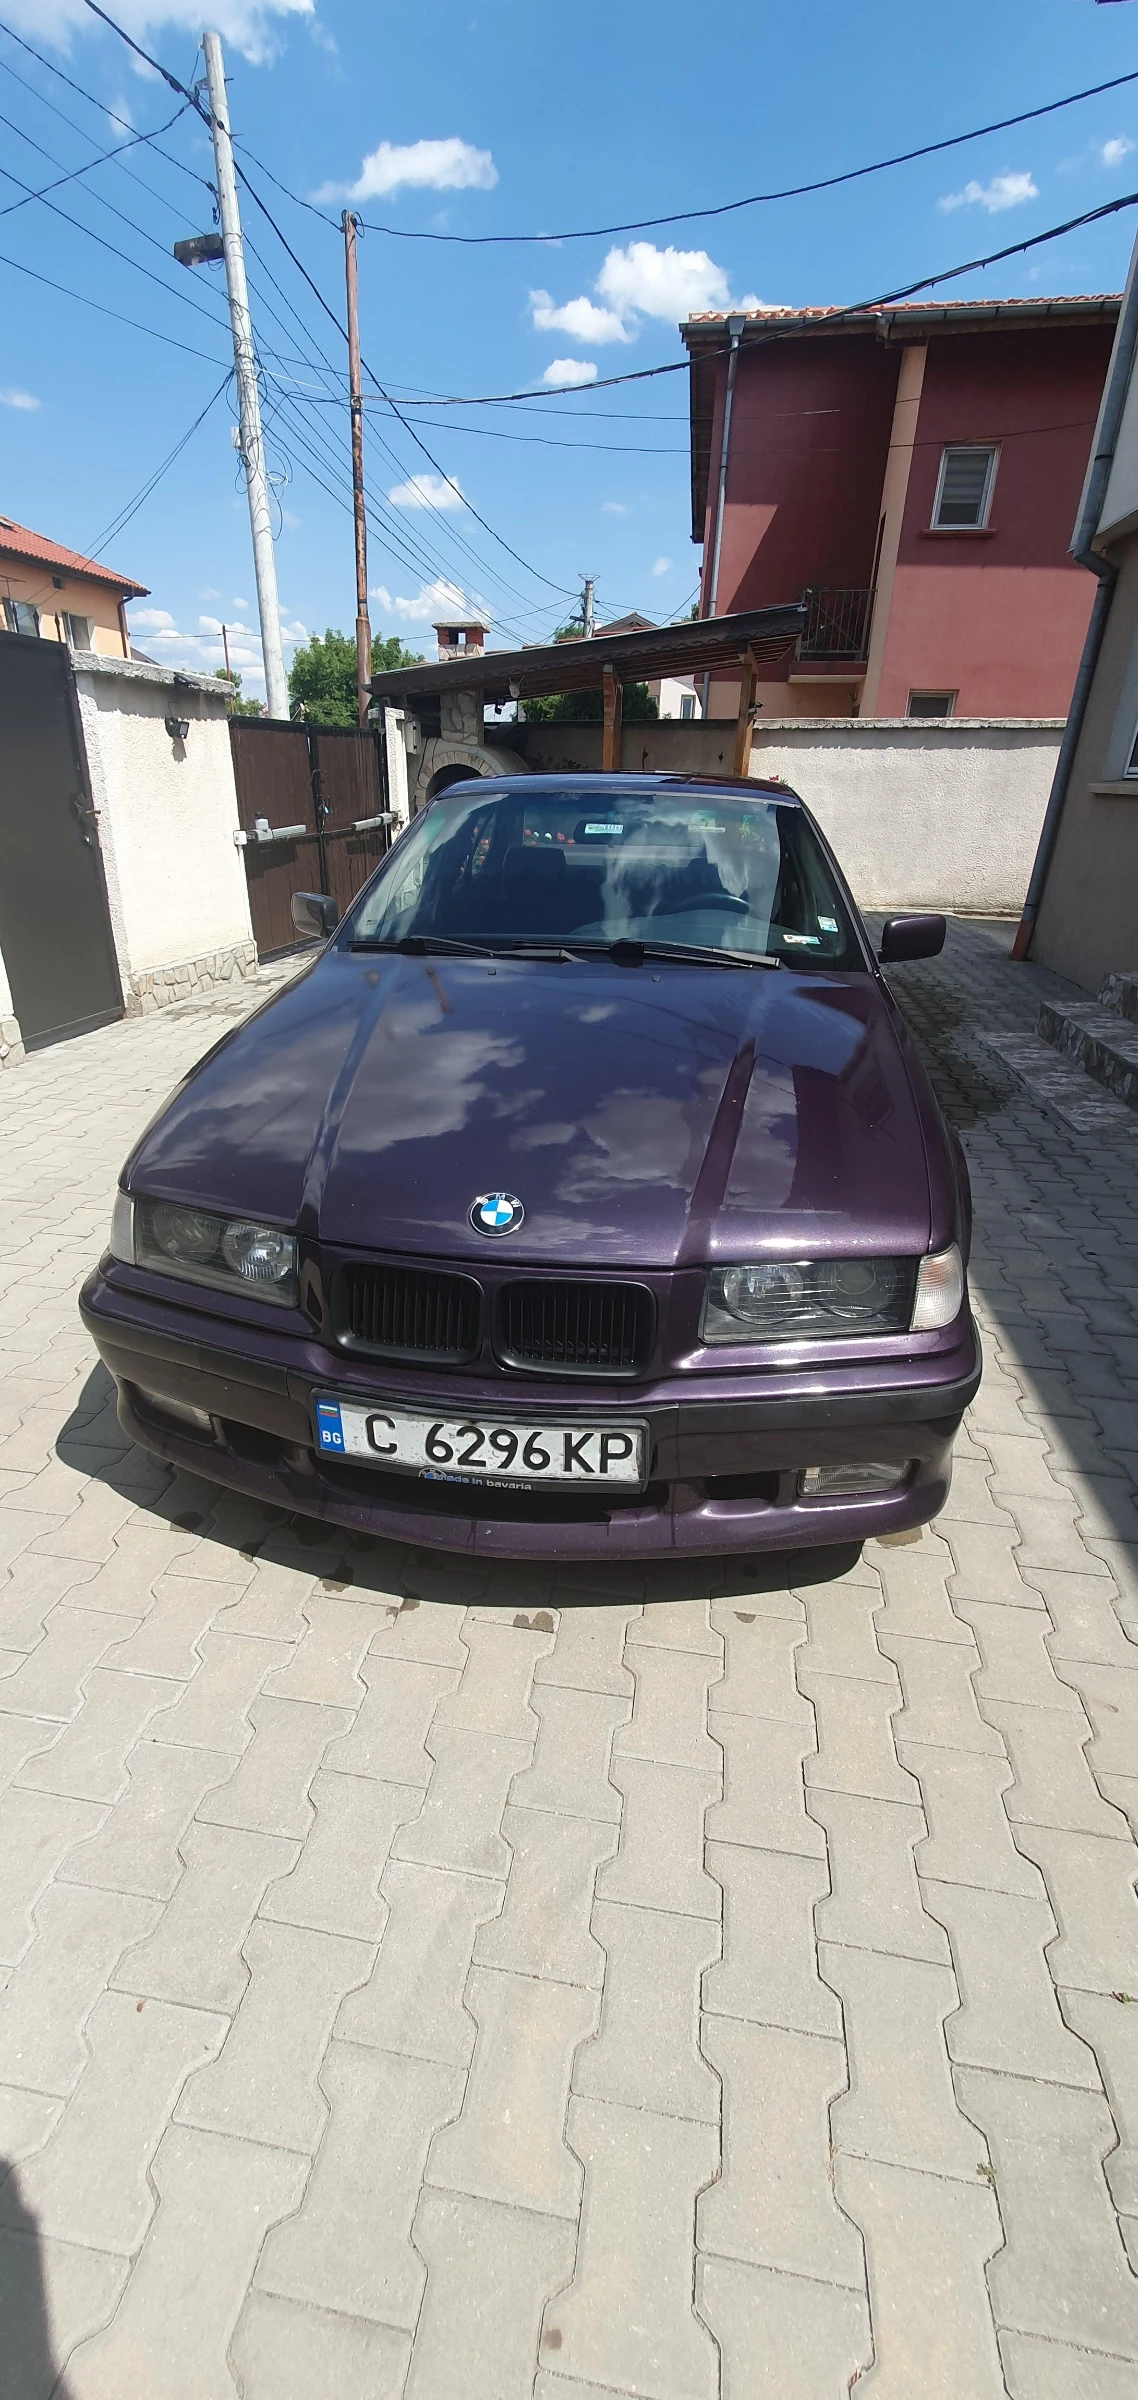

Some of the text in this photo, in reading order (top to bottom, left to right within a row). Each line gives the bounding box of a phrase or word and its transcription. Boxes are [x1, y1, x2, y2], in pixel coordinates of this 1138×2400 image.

[322, 1430, 342, 1444] BG
[365, 1413, 634, 1474] C 6296 KP
[472, 1477, 483, 1486] in
[486, 1479, 532, 1491] bavaria
